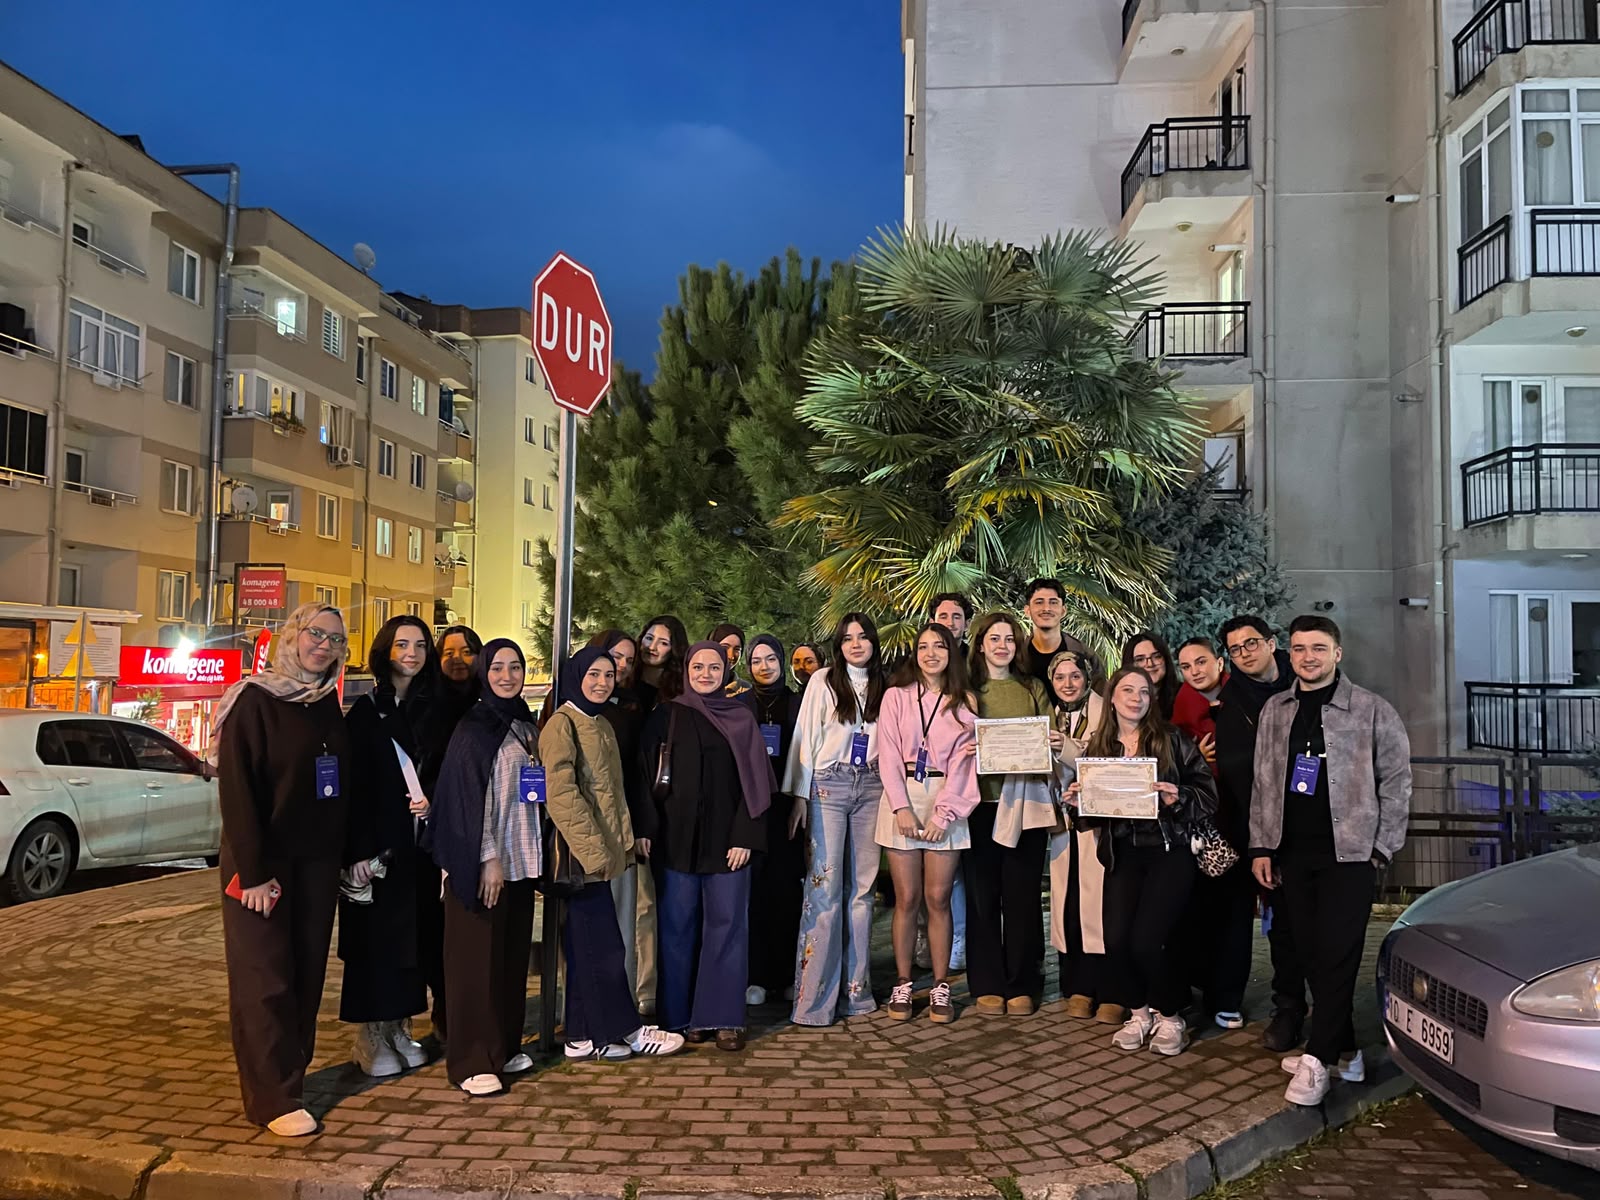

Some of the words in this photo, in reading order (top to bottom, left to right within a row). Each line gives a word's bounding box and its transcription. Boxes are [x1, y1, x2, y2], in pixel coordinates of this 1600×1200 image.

[541, 291, 605, 377] DUR
[241, 577, 281, 589] komagene
[142, 649, 225, 681] komgene
[1406, 1008, 1413, 1033] E
[1421, 1017, 1450, 1056] 6959
